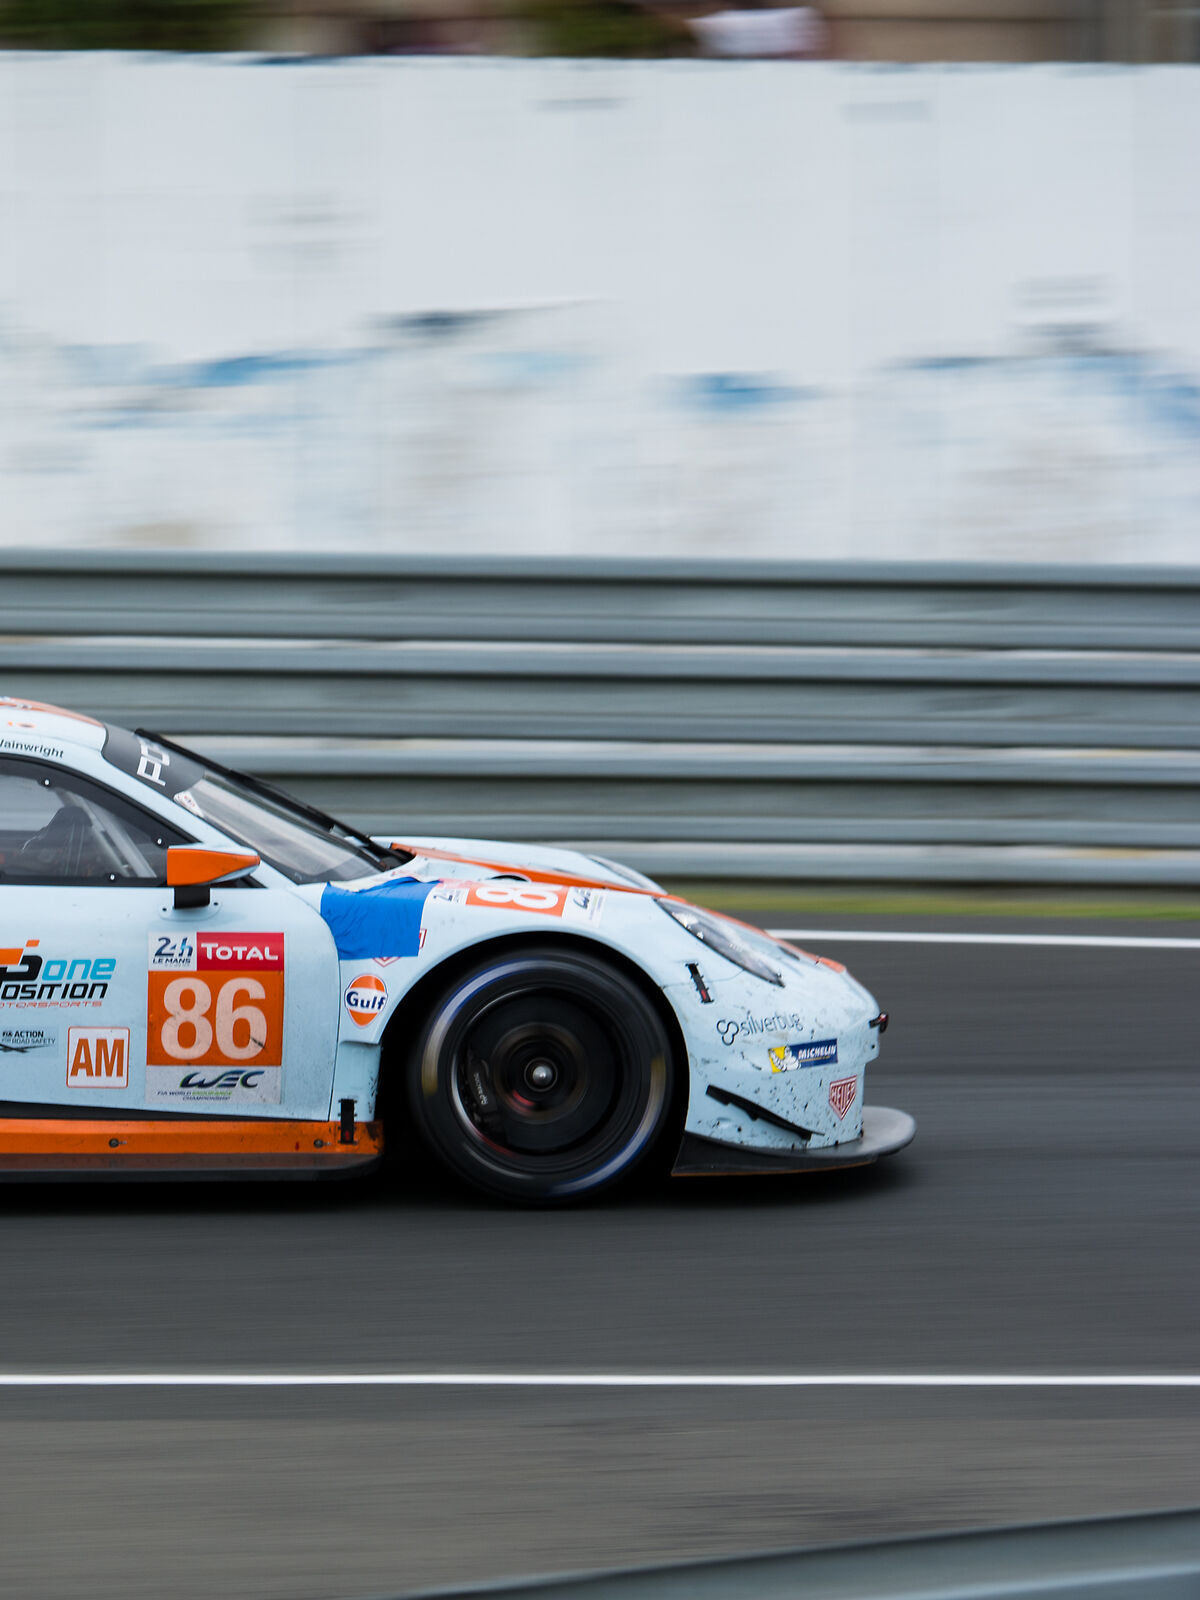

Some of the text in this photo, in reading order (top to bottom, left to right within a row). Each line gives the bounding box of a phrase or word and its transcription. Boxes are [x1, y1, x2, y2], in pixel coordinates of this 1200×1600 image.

[201, 943, 279, 961] TOTAL
[346, 990, 386, 1011] Gulf
[161, 977, 267, 1060] 86
[740, 1011, 804, 1036] silverbug
[70, 1038, 124, 1077] AM
[798, 1044, 837, 1060] MICHELIN
[180, 1069, 265, 1088] WEC
